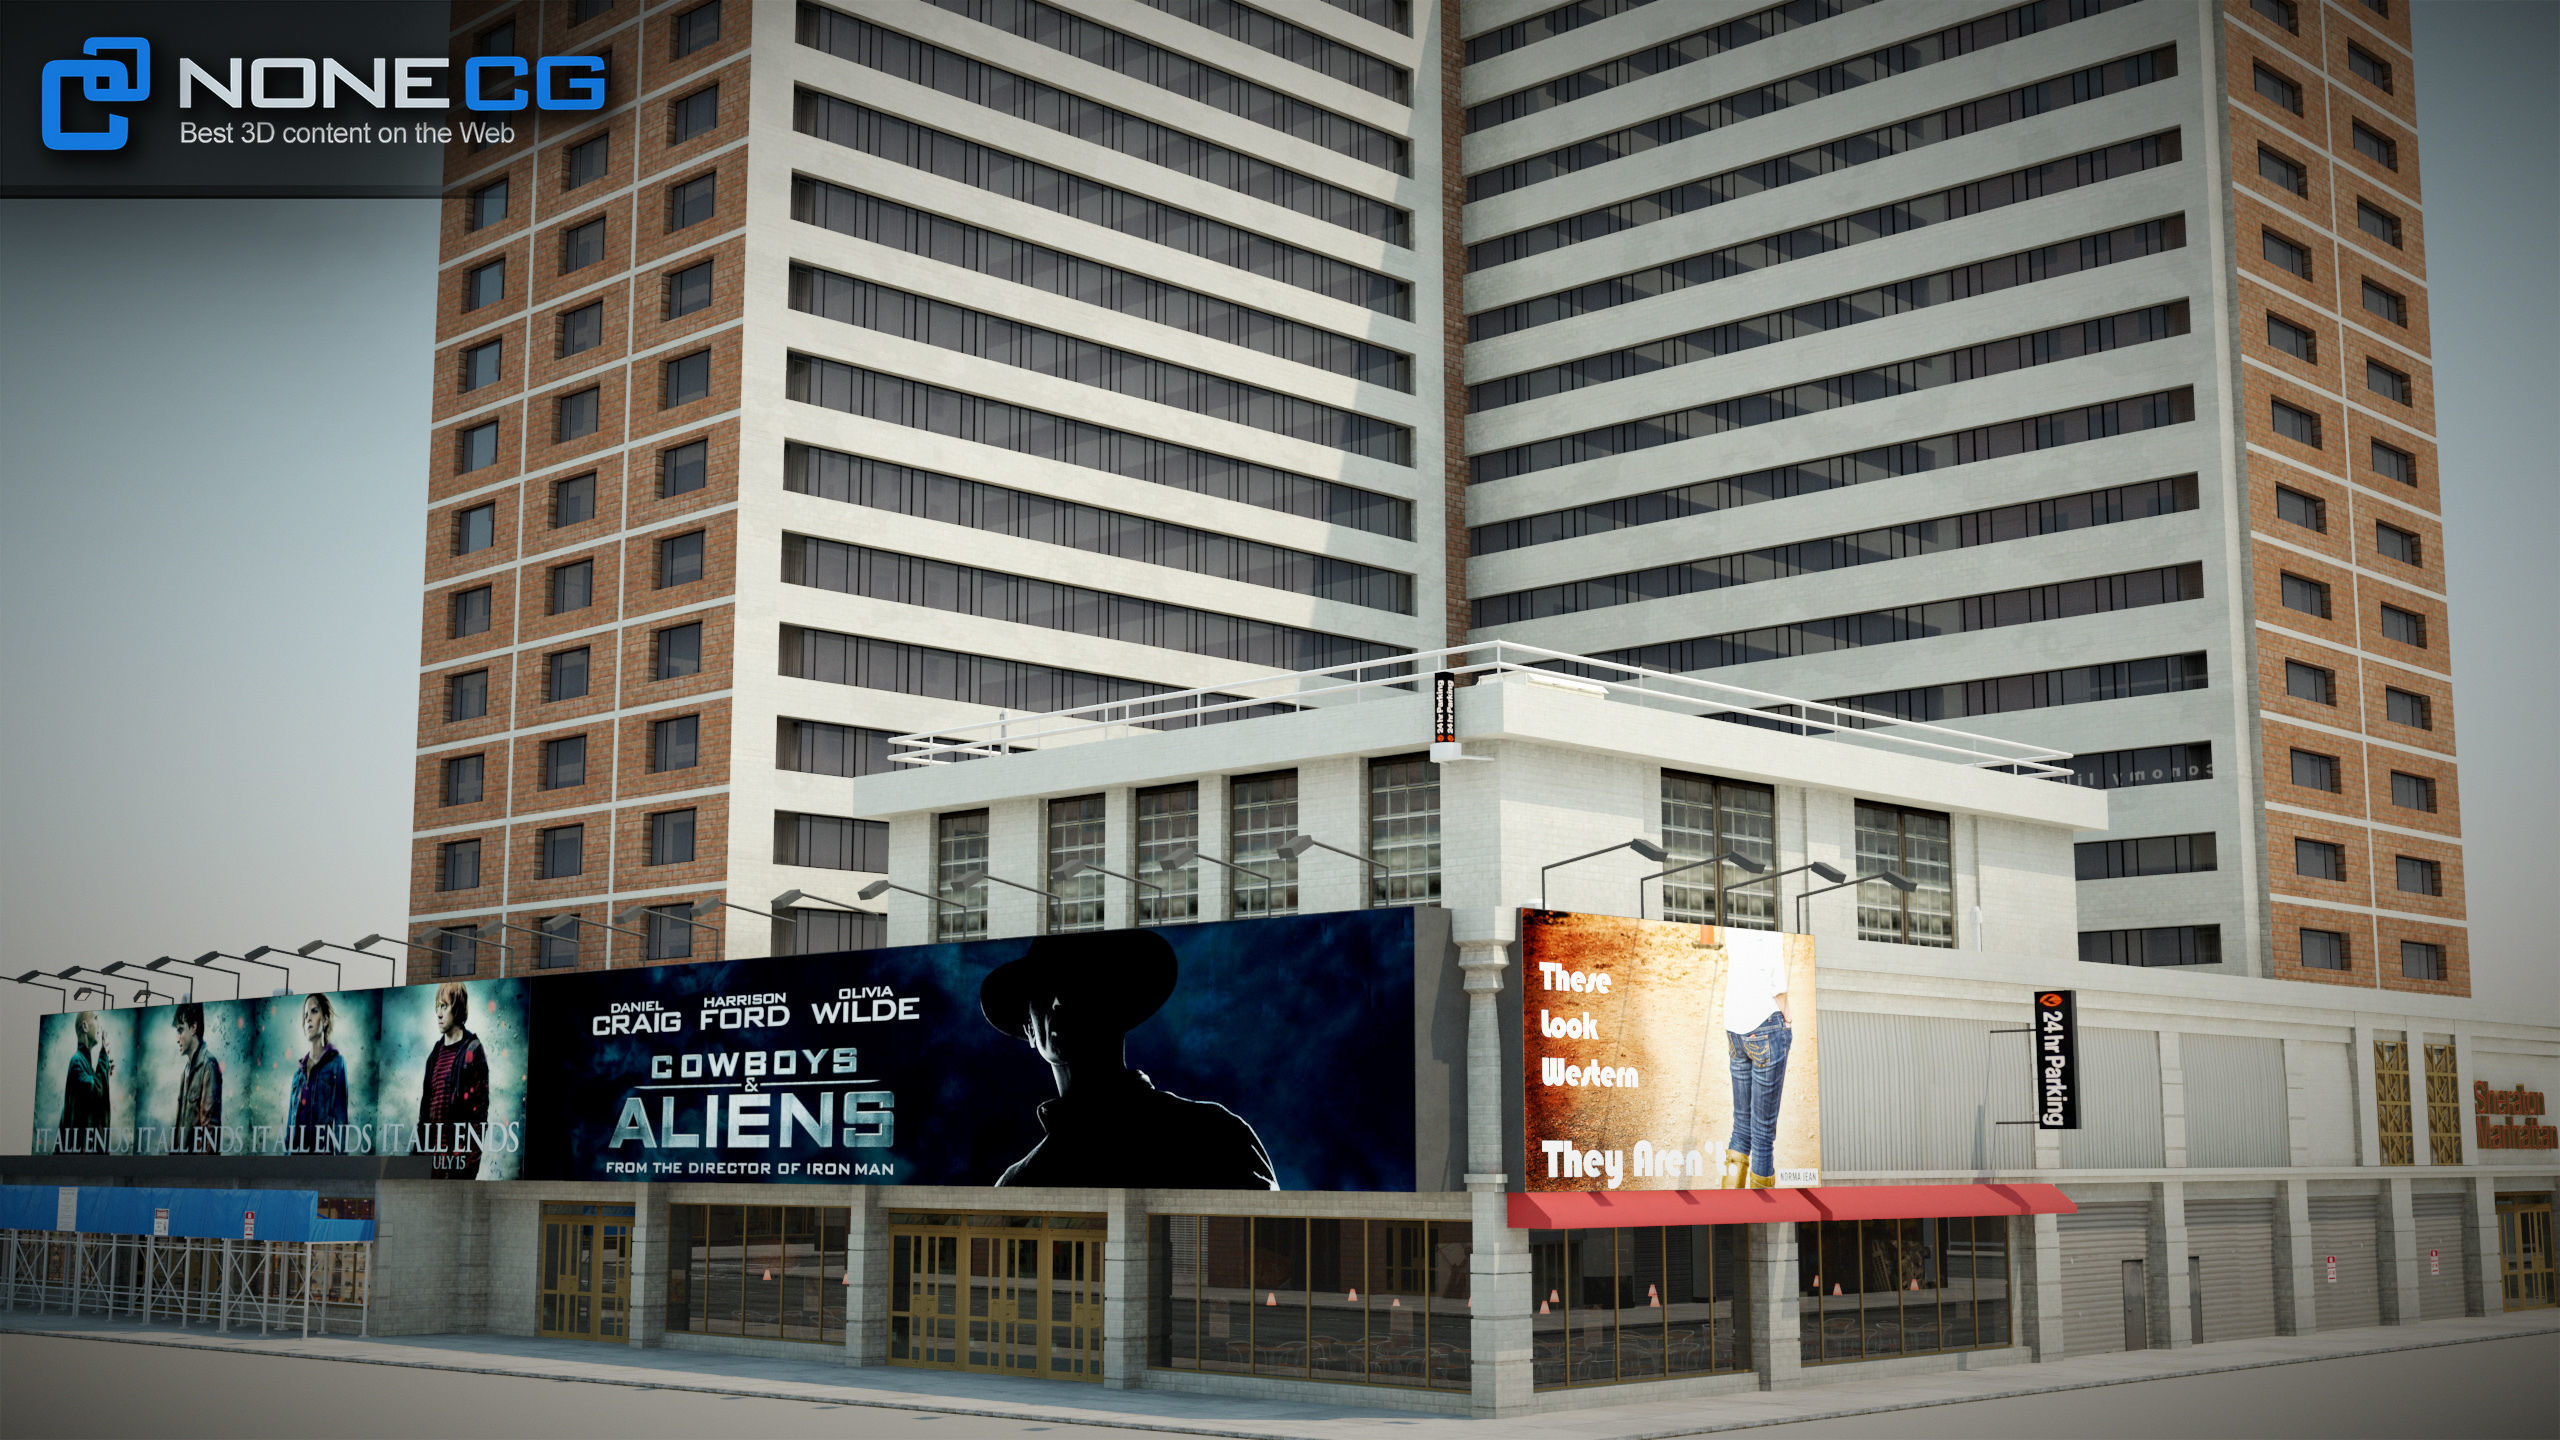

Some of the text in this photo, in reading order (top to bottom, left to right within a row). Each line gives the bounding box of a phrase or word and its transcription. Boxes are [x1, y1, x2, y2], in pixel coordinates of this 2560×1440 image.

[1436, 680, 1445, 713] Parking
[1446, 680, 1454, 713] Parking
[1437, 723, 1444, 734] 24
[1447, 723, 1454, 734] 24
[1539, 961, 1612, 994] These
[703, 992, 787, 1009] HARRISON
[838, 986, 894, 1000] OLIVIA
[610, 1001, 664, 1015] DANIEL
[700, 1005, 791, 1031] FORD
[811, 997, 920, 1025] WILDE
[592, 1011, 682, 1036] CRAIG
[1540, 1009, 1599, 1040] Look
[651, 1047, 858, 1079] COWBOYS
[1541, 1057, 1639, 1088] Western
[2042, 1010, 2068, 1126] 24 hr Parking
[744, 1077, 759, 1092] &
[2473, 1080, 2545, 1115] Sheraton
[608, 1090, 895, 1149] ALIENS
[2476, 1116, 2559, 1149] Manhattan
[35, 1126, 131, 1153] IT ALL ENDS
[136, 1125, 244, 1154] IT ALL ENDS
[251, 1123, 373, 1153] IT ALL ENDS
[382, 1121, 520, 1153] IT ALL ENDS
[433, 1155, 466, 1170] ULY 15
[606, 1162, 895, 1176] FROM THE DIRECTOR OF IRON MAN
[1541, 1140, 1623, 1189] They
